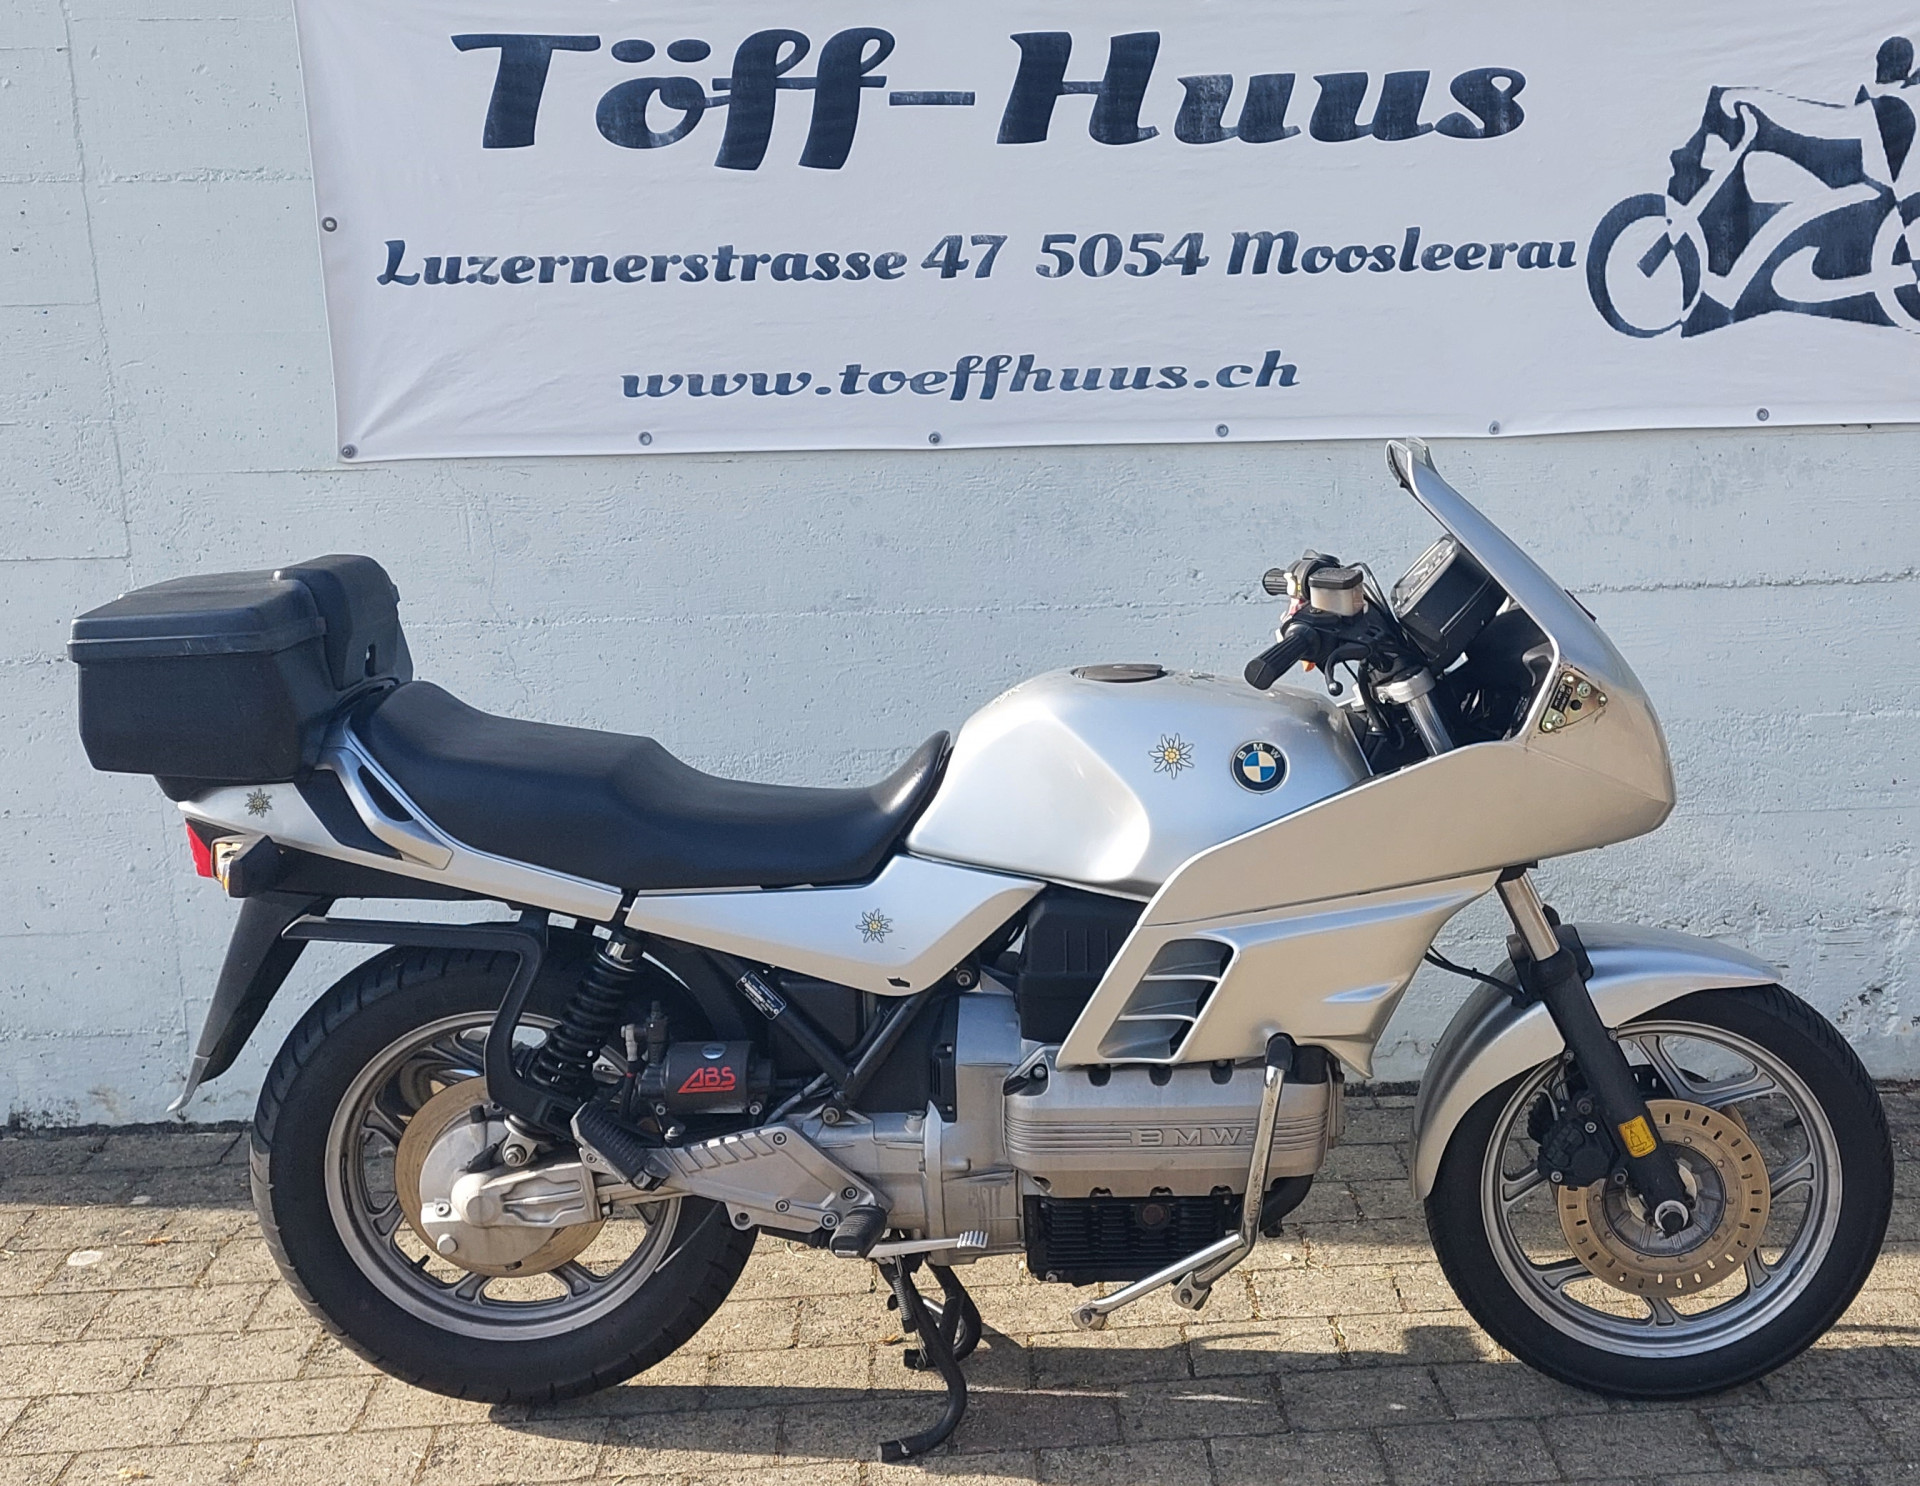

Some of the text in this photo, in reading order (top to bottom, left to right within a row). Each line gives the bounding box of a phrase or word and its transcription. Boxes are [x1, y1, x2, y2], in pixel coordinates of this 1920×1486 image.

[450, 27, 1527, 171] Töff-Huus
[376, 239, 908, 286] Luzernerstrasse
[920, 234, 1008, 279] 47
[1035, 232, 1210, 278] 5054
[621, 349, 1300, 402] www.toeffhuus.ch
[1236, 743, 1281, 761] BMW
[677, 1065, 737, 1094] ABS
[1138, 1127, 1242, 1147] BMW
